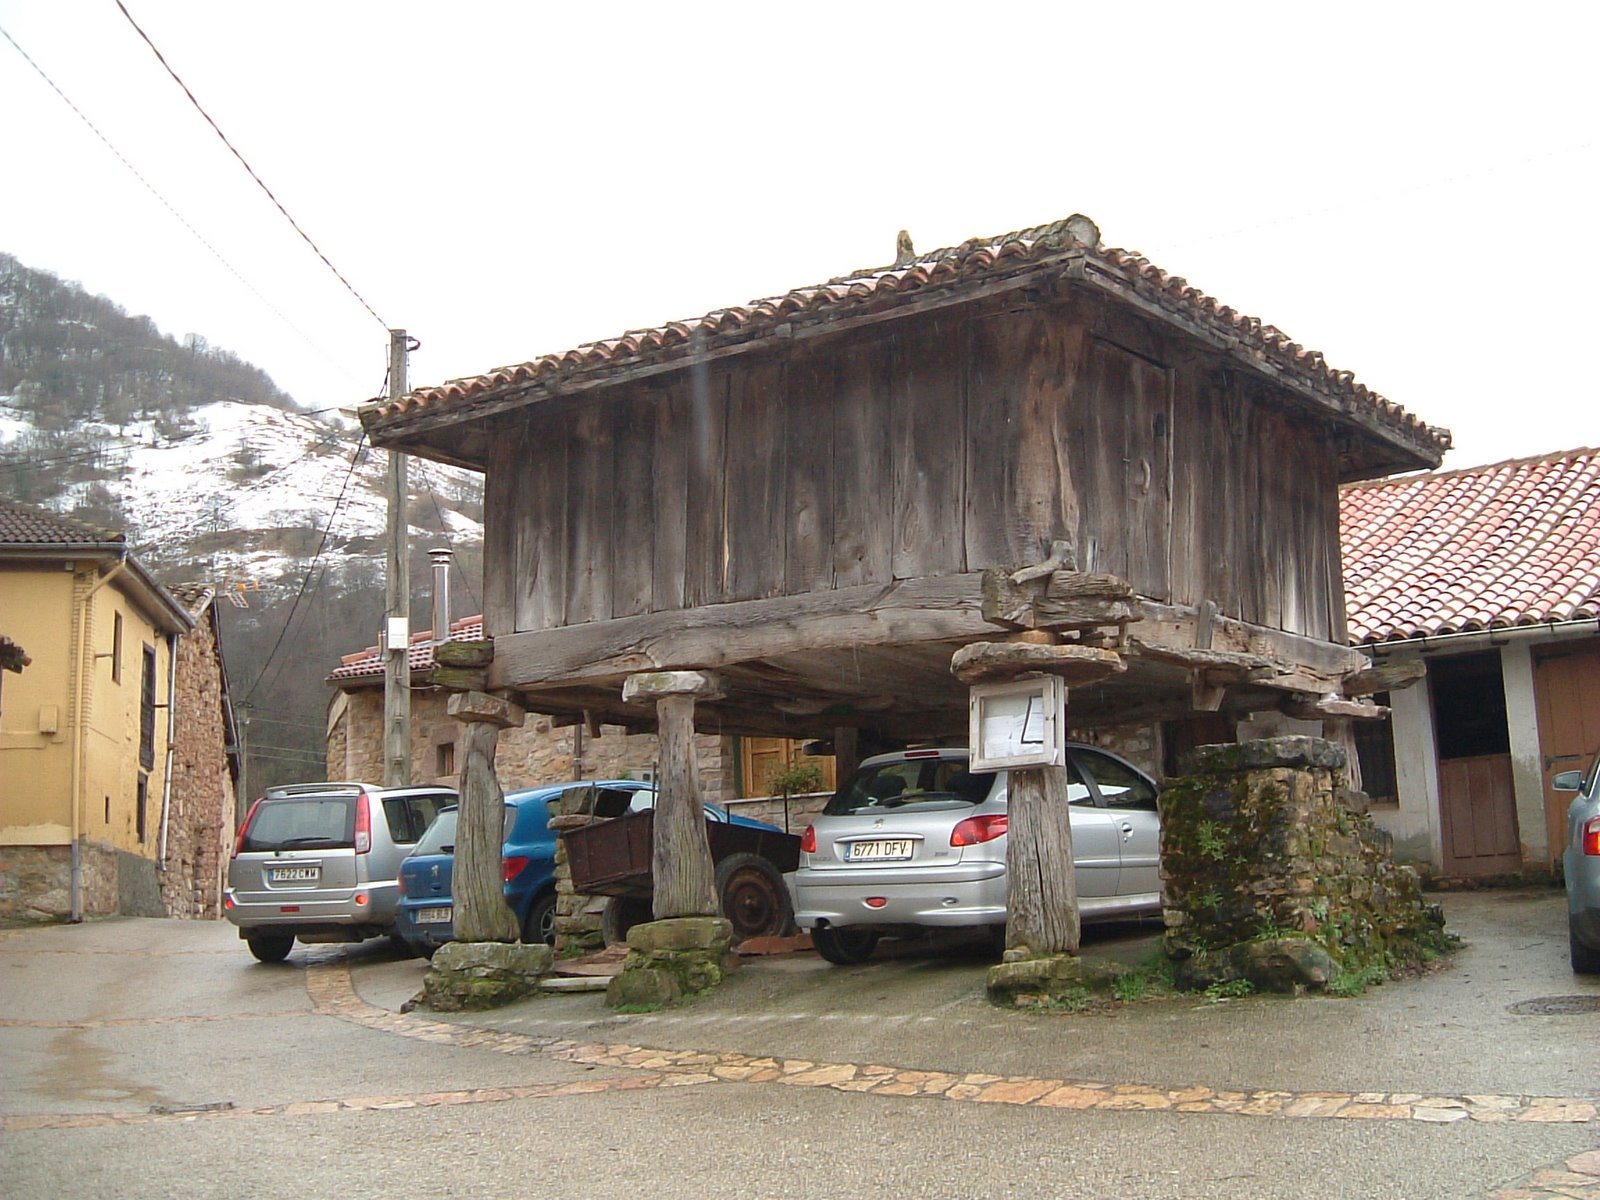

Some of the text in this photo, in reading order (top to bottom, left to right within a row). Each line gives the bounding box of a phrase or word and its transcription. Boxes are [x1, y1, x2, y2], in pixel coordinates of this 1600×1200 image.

[853, 841, 907, 856] 6771 DFV
[275, 869, 298, 880] 7622
